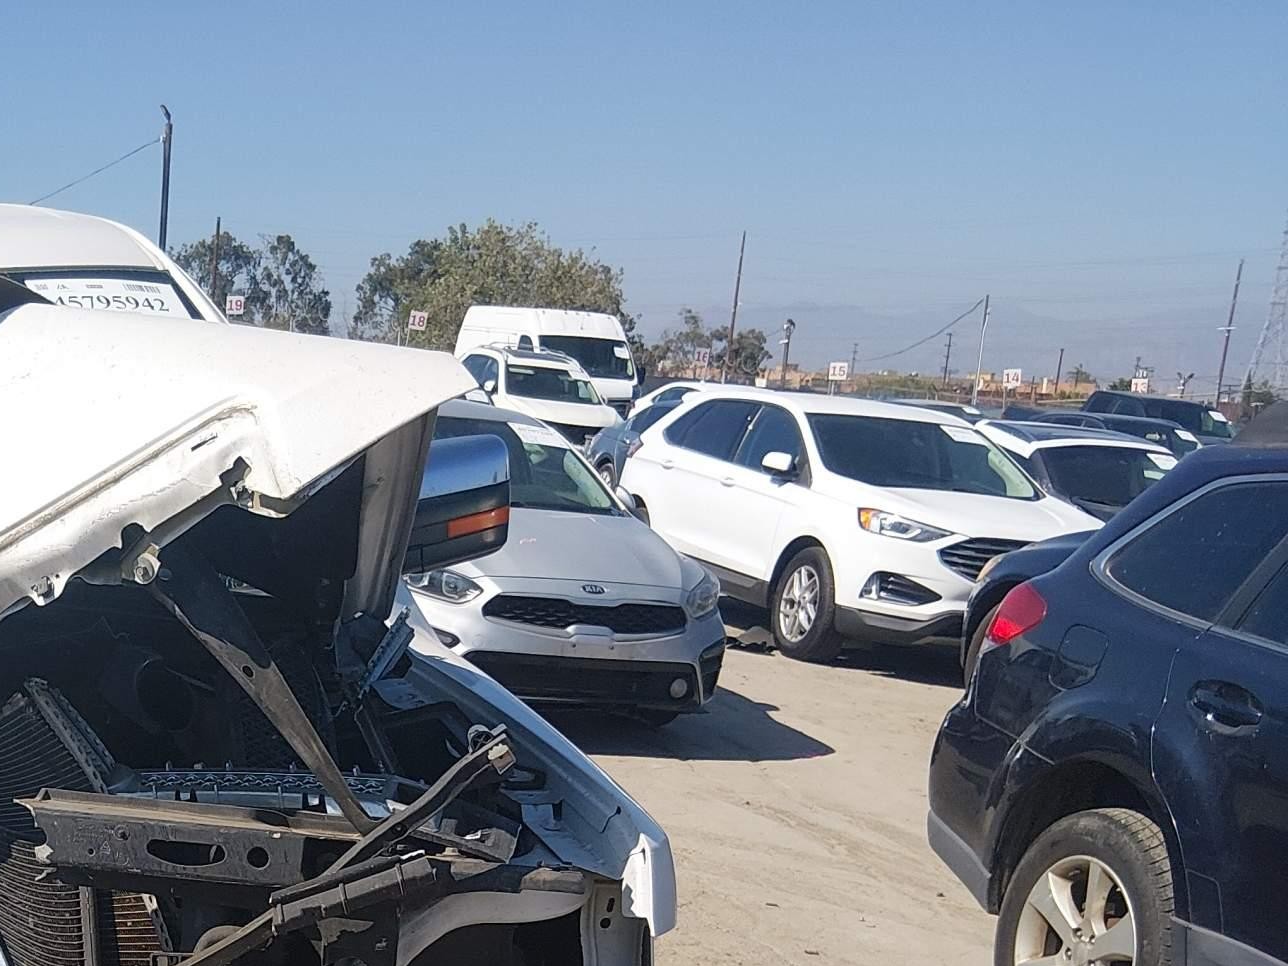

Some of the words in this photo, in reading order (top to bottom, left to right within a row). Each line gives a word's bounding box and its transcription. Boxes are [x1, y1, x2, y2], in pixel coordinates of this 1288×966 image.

[228, 299, 242, 311] 19
[410, 315, 425, 328] 18
[830, 366, 845, 377] 15
[1004, 371, 1019, 383] 14
[584, 585, 604, 593] KIA
